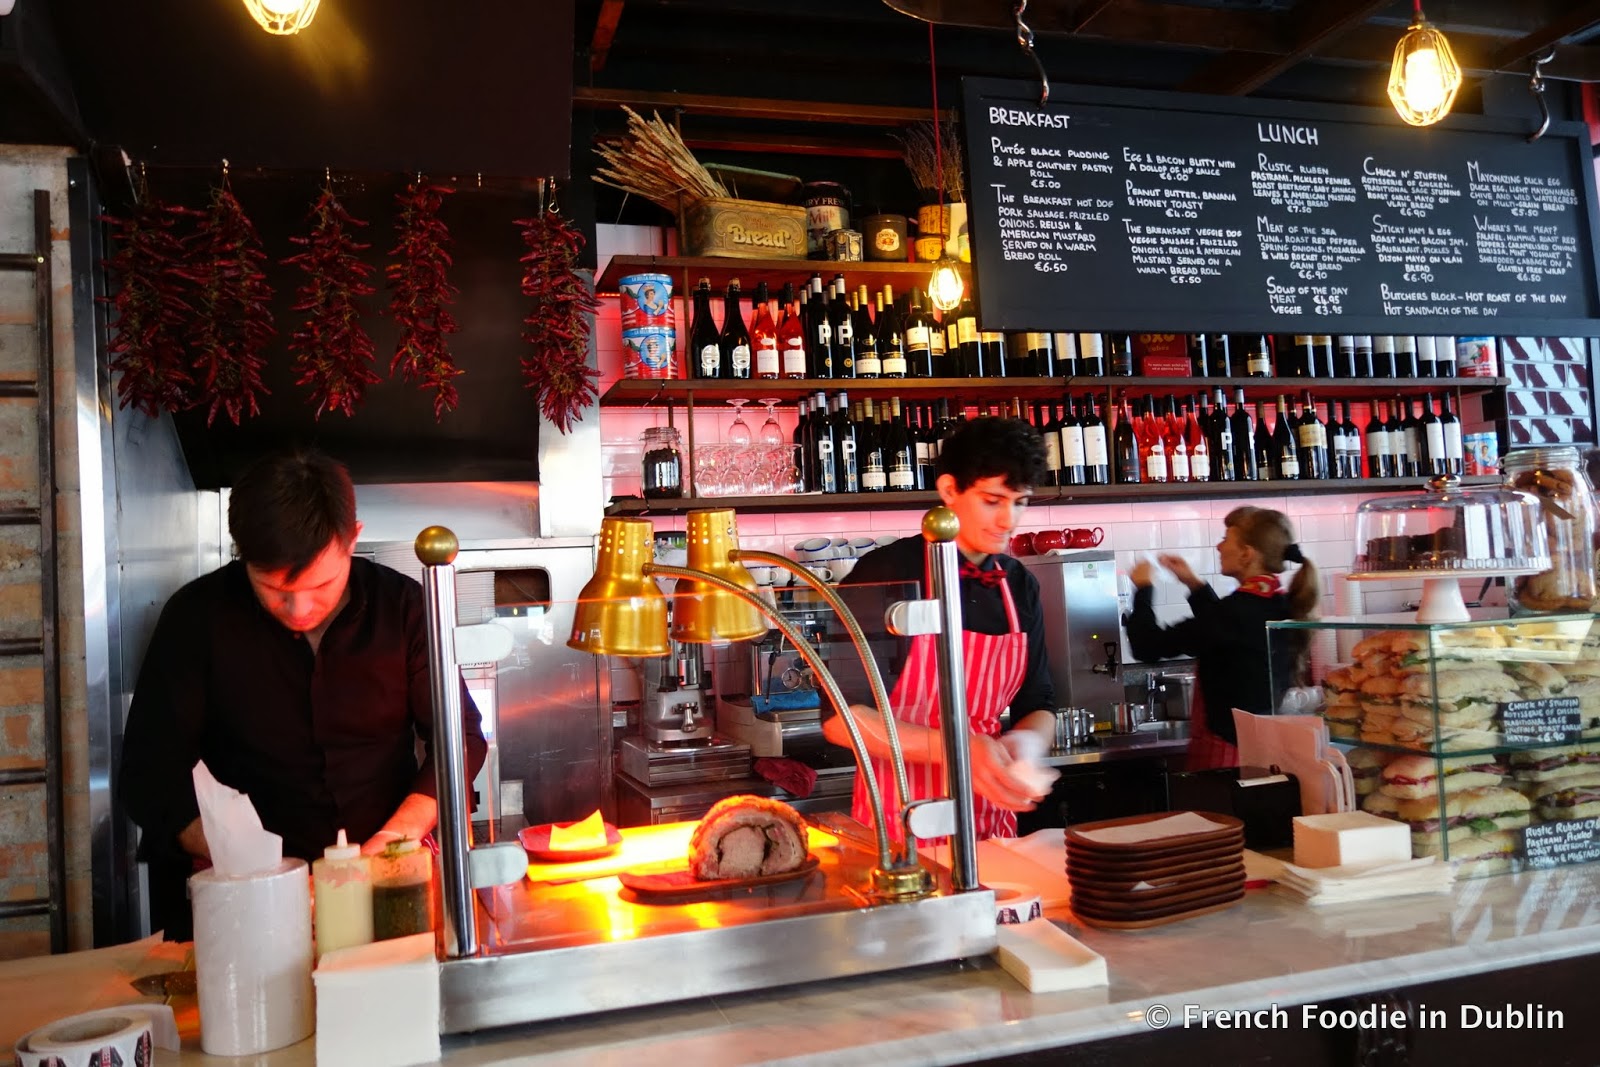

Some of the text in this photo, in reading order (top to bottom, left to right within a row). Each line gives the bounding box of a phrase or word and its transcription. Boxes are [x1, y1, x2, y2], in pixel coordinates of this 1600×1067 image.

[989, 107, 1070, 128] BREAKFAST
[1257, 123, 1318, 145] LUNCH
[1031, 148, 1110, 160] BLACK PUDDING
[1123, 147, 1236, 168] EGG BACON BUTTY WITH
[1008, 158, 1113, 174] APPLE CHUTNEY PASTRY
[1258, 153, 1328, 175] RUSTIC RUBEN
[1363, 157, 1447, 181] CHUCK STUFFIN
[1030, 170, 1053, 178] ROLL
[1140, 164, 1167, 172] DOLLOP
[1196, 168, 1220, 176] SAUCE
[1160, 173, 1188, 181] €6.00
[1293, 175, 1351, 185] PICKLED FENNEL
[1361, 176, 1403, 186] ROTISSERIE
[1524, 177, 1543, 185] DUCK
[1031, 180, 1061, 188] €5.00
[1363, 185, 1408, 193] TRADITIONAL
[1126, 179, 1236, 201] PEANUT BANANA
[1470, 183, 1575, 196] DUCK MAYONNAISE
[990, 184, 1014, 203] THE
[1023, 195, 1072, 206] BREAKFAST
[1077, 199, 1092, 207] HOT
[1253, 190, 1281, 198] LEAVES
[1291, 192, 1325, 200] AMERICAN
[1367, 192, 1388, 200] ROAST
[1470, 192, 1492, 200] CHIVE
[1533, 195, 1578, 205] WATERCRESS
[1137, 198, 1203, 210] HONEY TOASTY
[1410, 202, 1433, 210] BREAD
[1543, 203, 1565, 211] BREAD
[998, 207, 1109, 221] PORK FRIZZLED
[1166, 209, 1197, 218] €4.00
[1400, 208, 1426, 217] €6.90
[1511, 208, 1538, 216] €5.50
[1040, 220, 1070, 229] RELISH
[1122, 219, 1141, 233] THE
[1146, 226, 1191, 235] BREAKFAST
[1196, 228, 1223, 237] VEGGIE
[1257, 216, 1283, 233] MEAT
[1321, 228, 1336, 236] SEA
[1373, 214, 1404, 234] STICKY
[1437, 228, 1451, 236] EGG
[727, 224, 791, 248] Bread
[1001, 229, 1096, 242] AMERICAN MUSTARD
[1371, 234, 1446, 245] ROAST BACON
[1540, 236, 1558, 244] ROAST
[1002, 240, 1096, 251] SERVED ON WARM
[1129, 236, 1238, 247] VEGGIE FRIZZLED
[1261, 242, 1289, 251] SPRING
[1169, 247, 1241, 256] RELISH AMERICAN
[1508, 242, 1576, 252] CARAMELISED ONIONS
[1004, 251, 1061, 260] BREAD ROLL
[1133, 255, 1172, 264] MUSTARD
[1176, 257, 1205, 265] SERVED
[1291, 253, 1318, 261] ROCKET
[1379, 254, 1425, 263] DIJON MAYO
[1529, 251, 1560, 259] YOGHURT
[1479, 255, 1547, 266] SHREDDED CABBAGE
[1034, 262, 1067, 272] €6.50
[1170, 266, 1198, 275] BREAD
[1290, 262, 1314, 270] GRAIN
[1405, 264, 1430, 273] BREAD
[1526, 266, 1566, 275] FREE WRAP
[1170, 276, 1201, 284] €5.50
[1298, 270, 1327, 280] €6.90
[1403, 272, 1434, 283] €6.90
[1266, 276, 1295, 294] SOUP
[1312, 287, 1327, 295] THE
[1331, 287, 1348, 295] DAY
[1381, 283, 1567, 303] BUTCHERS HOT ROAST OF THE DAY
[1270, 295, 1339, 305] MEAT €4.95
[1271, 305, 1342, 315] VEGGIE €3.95
[1384, 302, 1497, 316] HOT SANDWICH THE DAY
[1508, 702, 1535, 711] CHUCK
